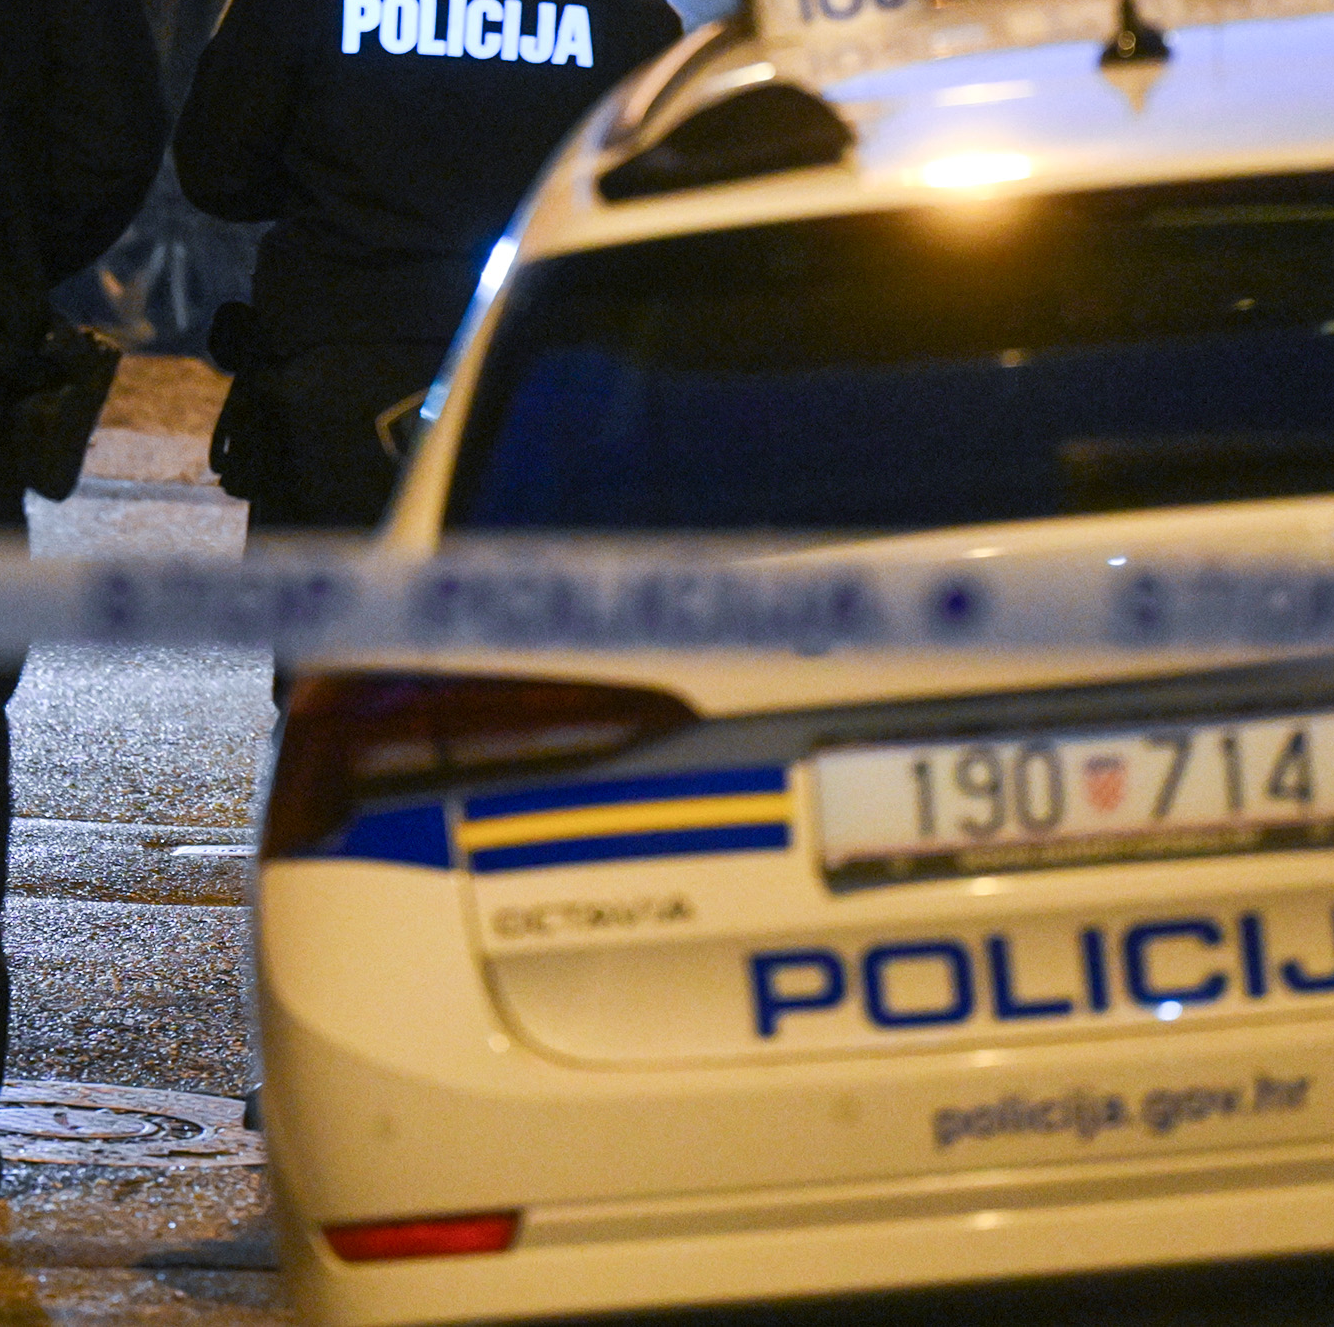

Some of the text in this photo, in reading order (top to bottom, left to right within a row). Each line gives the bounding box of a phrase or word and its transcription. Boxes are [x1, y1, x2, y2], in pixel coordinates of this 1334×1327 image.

[910, 728, 1319, 837] 190 714
[933, 1074, 1310, 1150] policija.gov.hr
